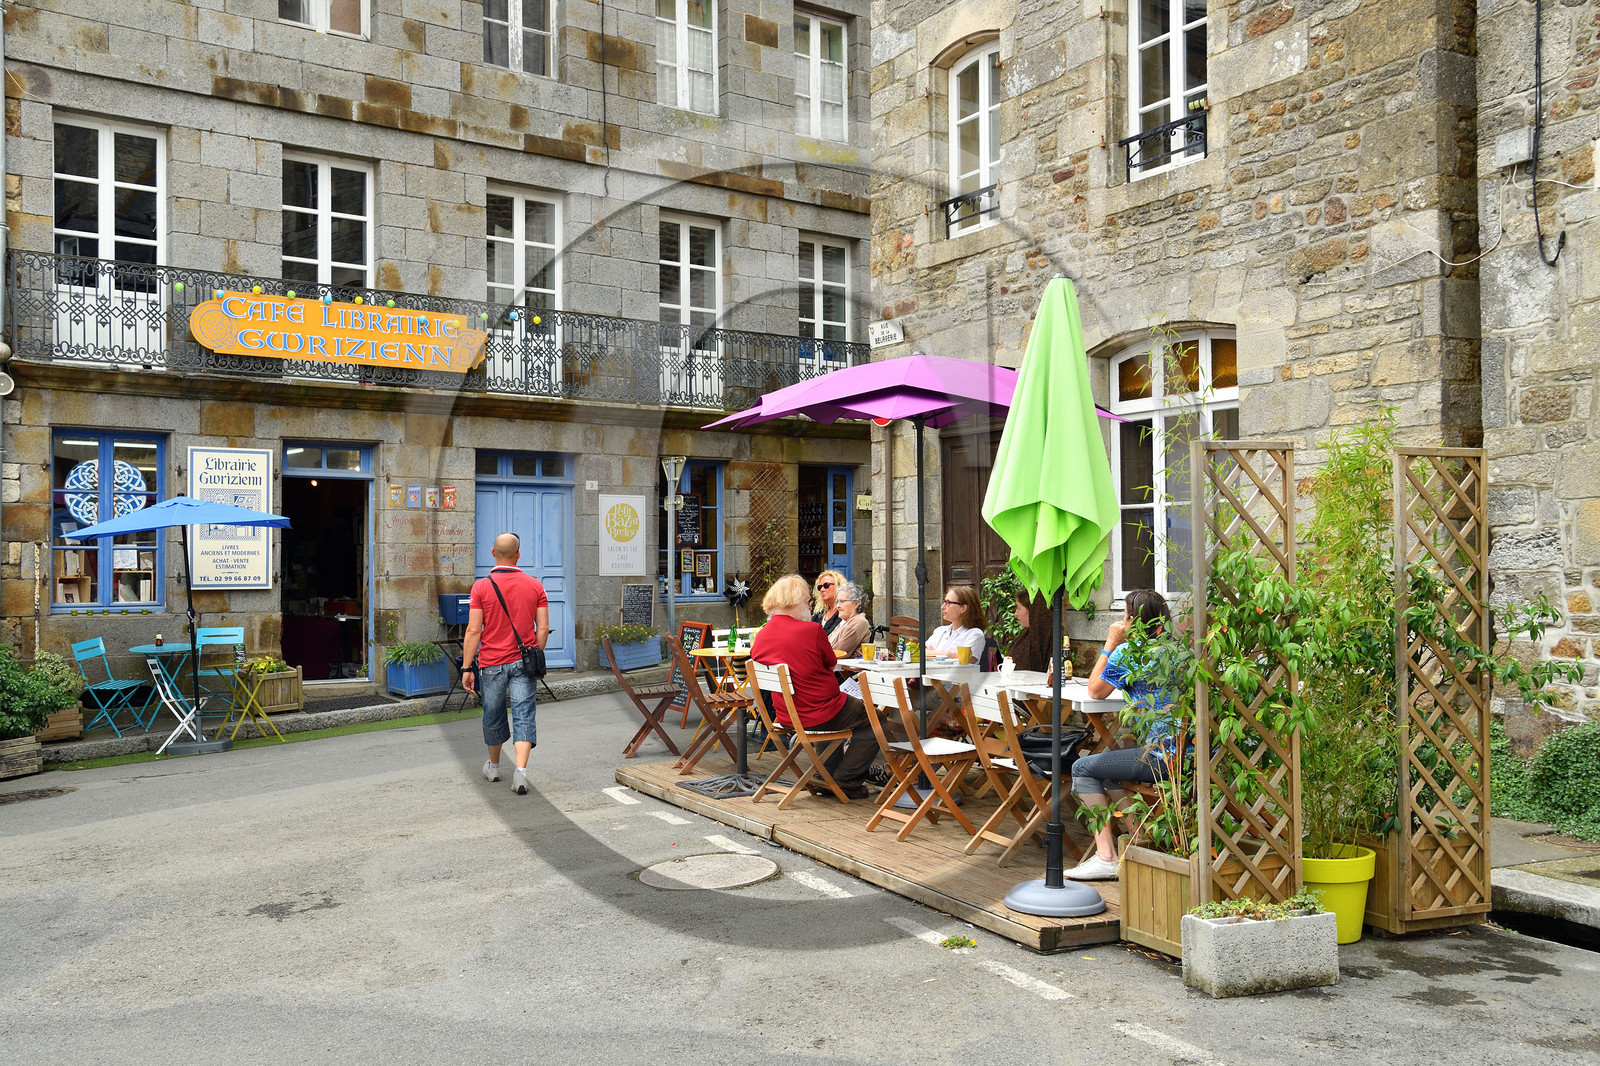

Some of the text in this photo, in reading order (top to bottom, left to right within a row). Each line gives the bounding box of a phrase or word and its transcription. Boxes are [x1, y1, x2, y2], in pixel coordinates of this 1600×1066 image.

[320, 305, 459, 339] LIBRAIRIE
[237, 328, 453, 367] GWRIZIENN
[205, 457, 257, 471] Librairie
[199, 471, 262, 486] Gwrizienn
[614, 503, 632, 516] Petit
[609, 526, 638, 538] Breton
